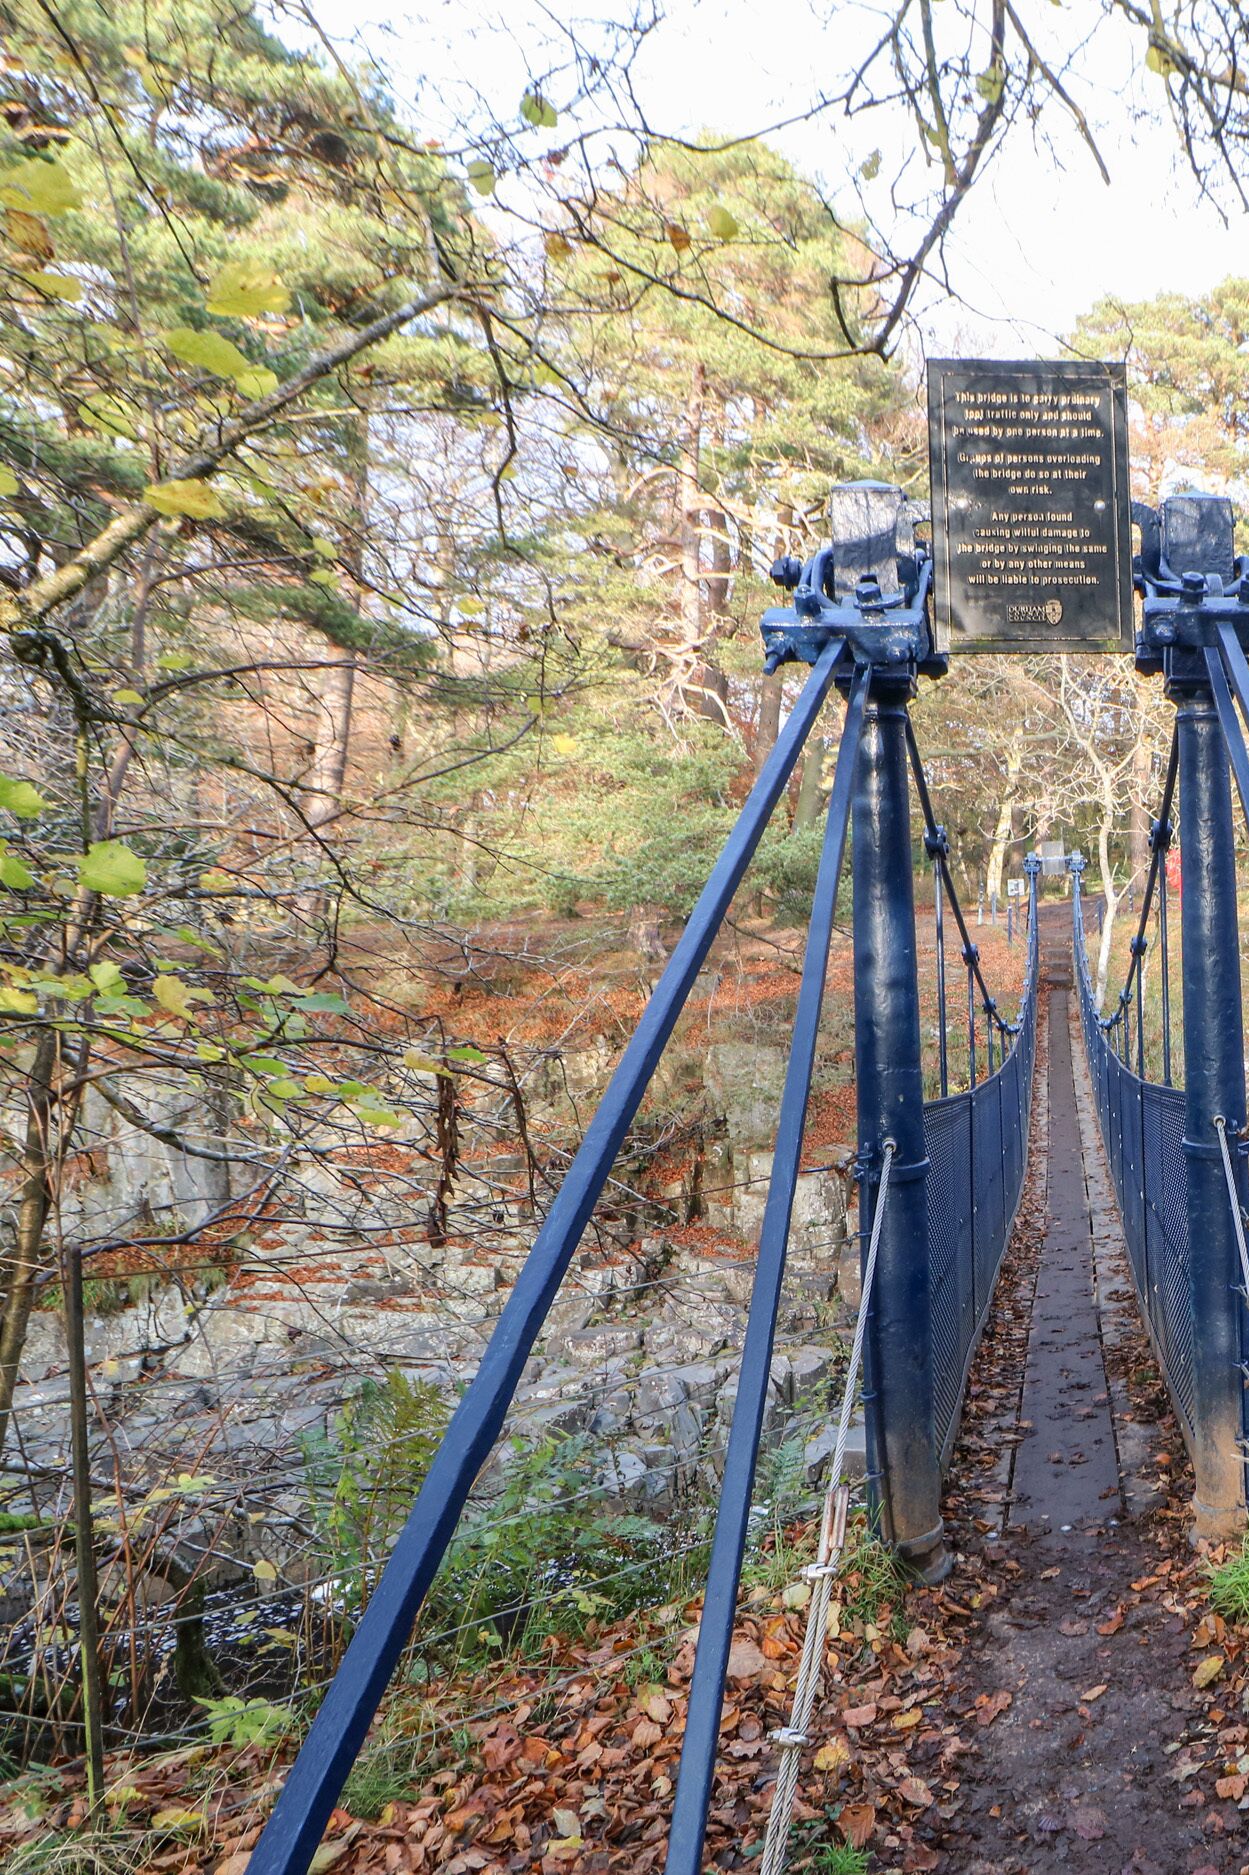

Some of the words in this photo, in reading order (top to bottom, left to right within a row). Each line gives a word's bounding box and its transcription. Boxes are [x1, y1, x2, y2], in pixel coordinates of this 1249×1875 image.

[955, 392, 974, 404] This
[977, 393, 1007, 404] bridge
[1010, 393, 1018, 403] is
[1022, 393, 1032, 403] to
[1033, 393, 1058, 405] carry
[1061, 394, 1100, 408] ordinary
[988, 409, 1016, 419] traffic
[1020, 410, 1038, 422] only
[1042, 410, 1058, 420] and
[1061, 410, 1091, 421] should
[992, 426, 1003, 439] by
[1006, 428, 1023, 437] one
[1026, 428, 1057, 438] person
[1060, 427, 1069, 437] at
[1073, 429, 1078, 438] a
[1081, 427, 1104, 438] time.
[995, 453, 1004, 464] of
[1006, 454, 1044, 465] persons
[1047, 454, 1100, 466] overloading
[974, 469, 989, 478] the
[992, 469, 1021, 480] bridge
[1025, 469, 1036, 478] do
[1039, 470, 1049, 479] so
[1053, 469, 1061, 479] at
[1064, 469, 1087, 479] their
[1009, 486, 1029, 495] own
[1032, 485, 1052, 494] risk.
[992, 512, 1009, 522] Any
[1011, 513, 1044, 523] person
[1047, 512, 1072, 521] found
[974, 528, 1010, 538] causing
[1013, 528, 1039, 537] wilful
[1043, 528, 1077, 539] damage
[1081, 528, 1089, 538] to
[957, 544, 972, 554] the
[975, 544, 1005, 554] bridge
[1008, 544, 1018, 554] by
[1022, 544, 1062, 555] swinging
[1065, 544, 1080, 553] the
[1083, 545, 1107, 553] same
[982, 560, 991, 568] or
[995, 559, 1004, 570] by
[1009, 560, 1024, 570] any
[1028, 559, 1052, 568] other
[1056, 560, 1085, 569] means
[969, 575, 985, 584] will
[988, 575, 998, 584] be
[1002, 575, 1027, 584] liable
[1031, 576, 1039, 584] to
[1042, 575, 1099, 586] prosecution.
